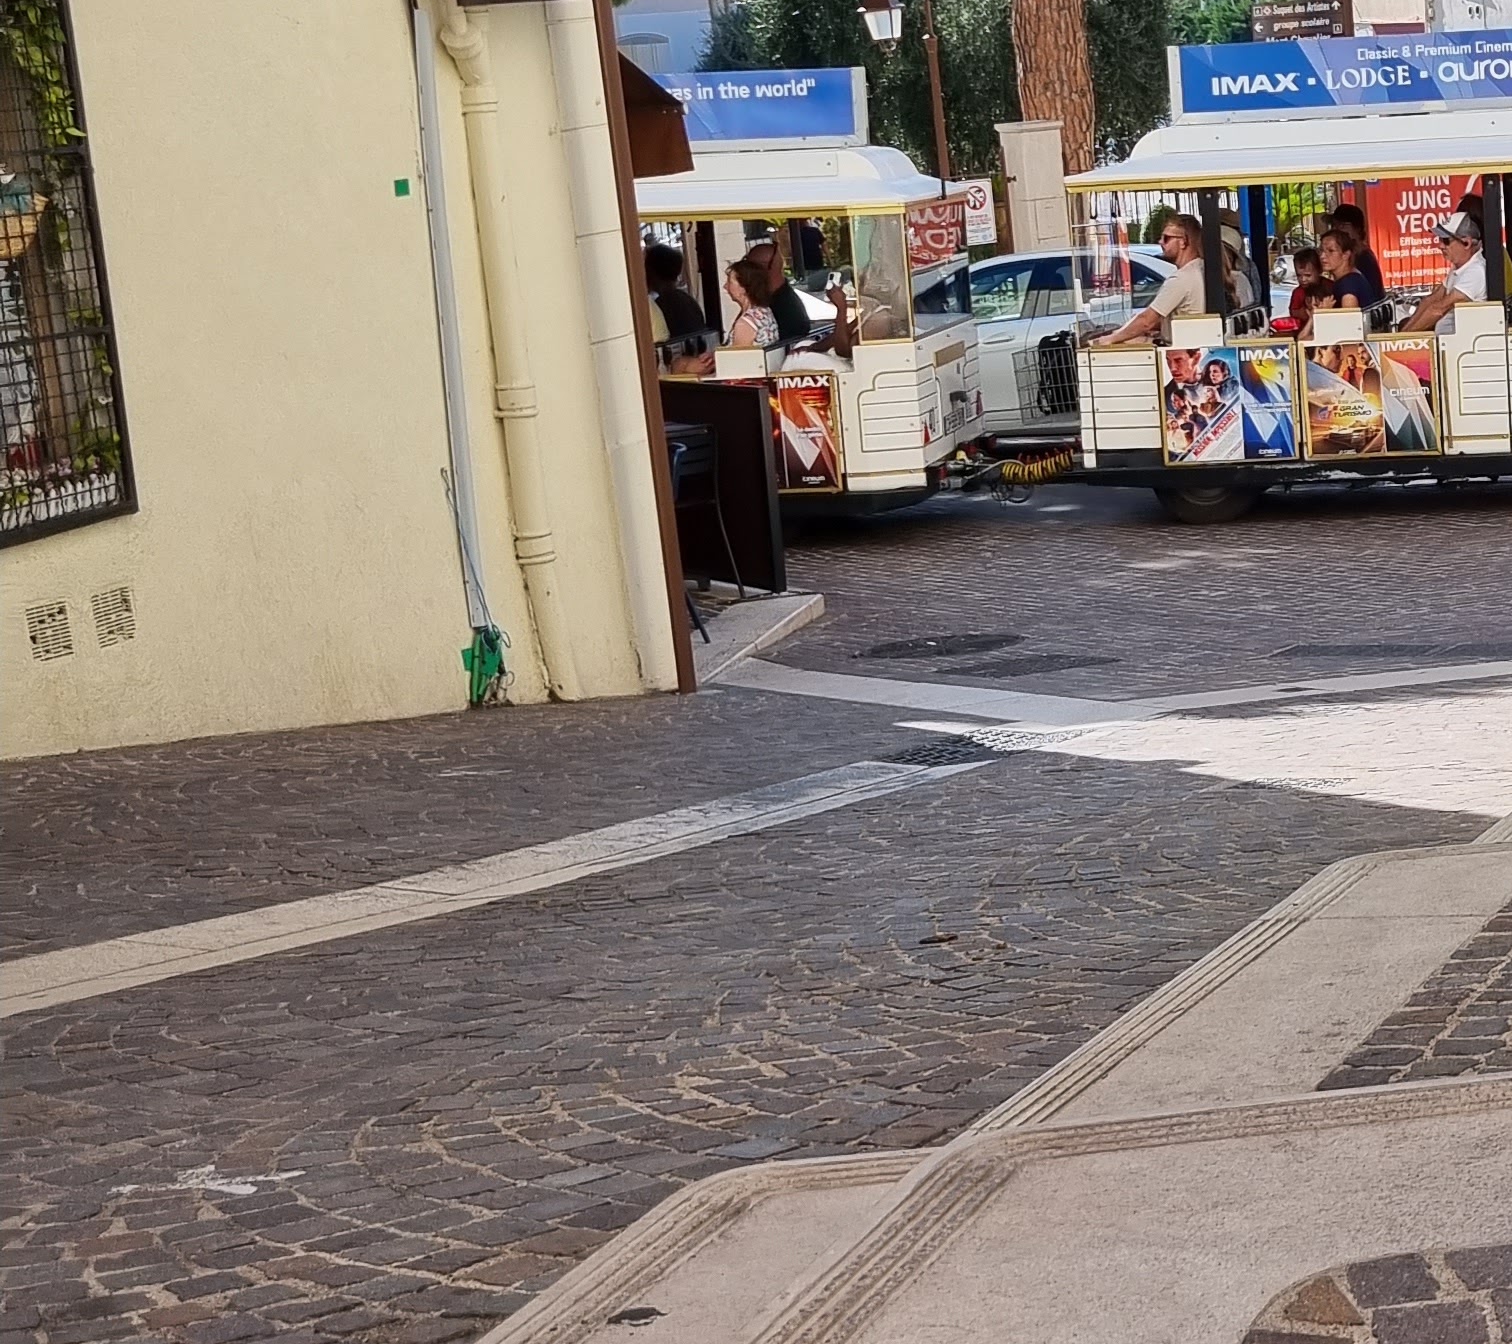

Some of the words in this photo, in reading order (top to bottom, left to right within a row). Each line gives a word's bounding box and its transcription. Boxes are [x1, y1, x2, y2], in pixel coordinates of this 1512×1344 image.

[1357, 46, 1399, 61] Classic
[1401, 44, 1412, 58] &
[1415, 43, 1472, 57] Premium
[1211, 72, 1299, 96] IMAX
[1326, 65, 1412, 90] LODGE
[665, 87, 693, 101] as
[697, 82, 714, 100] in
[718, 81, 751, 100] the
[1396, 188, 1451, 211] JUNG
[1381, 339, 1430, 352] IMAX
[1240, 348, 1290, 361] IMAX
[779, 375, 830, 389] IMAX
[1389, 386, 1430, 397] cineum
